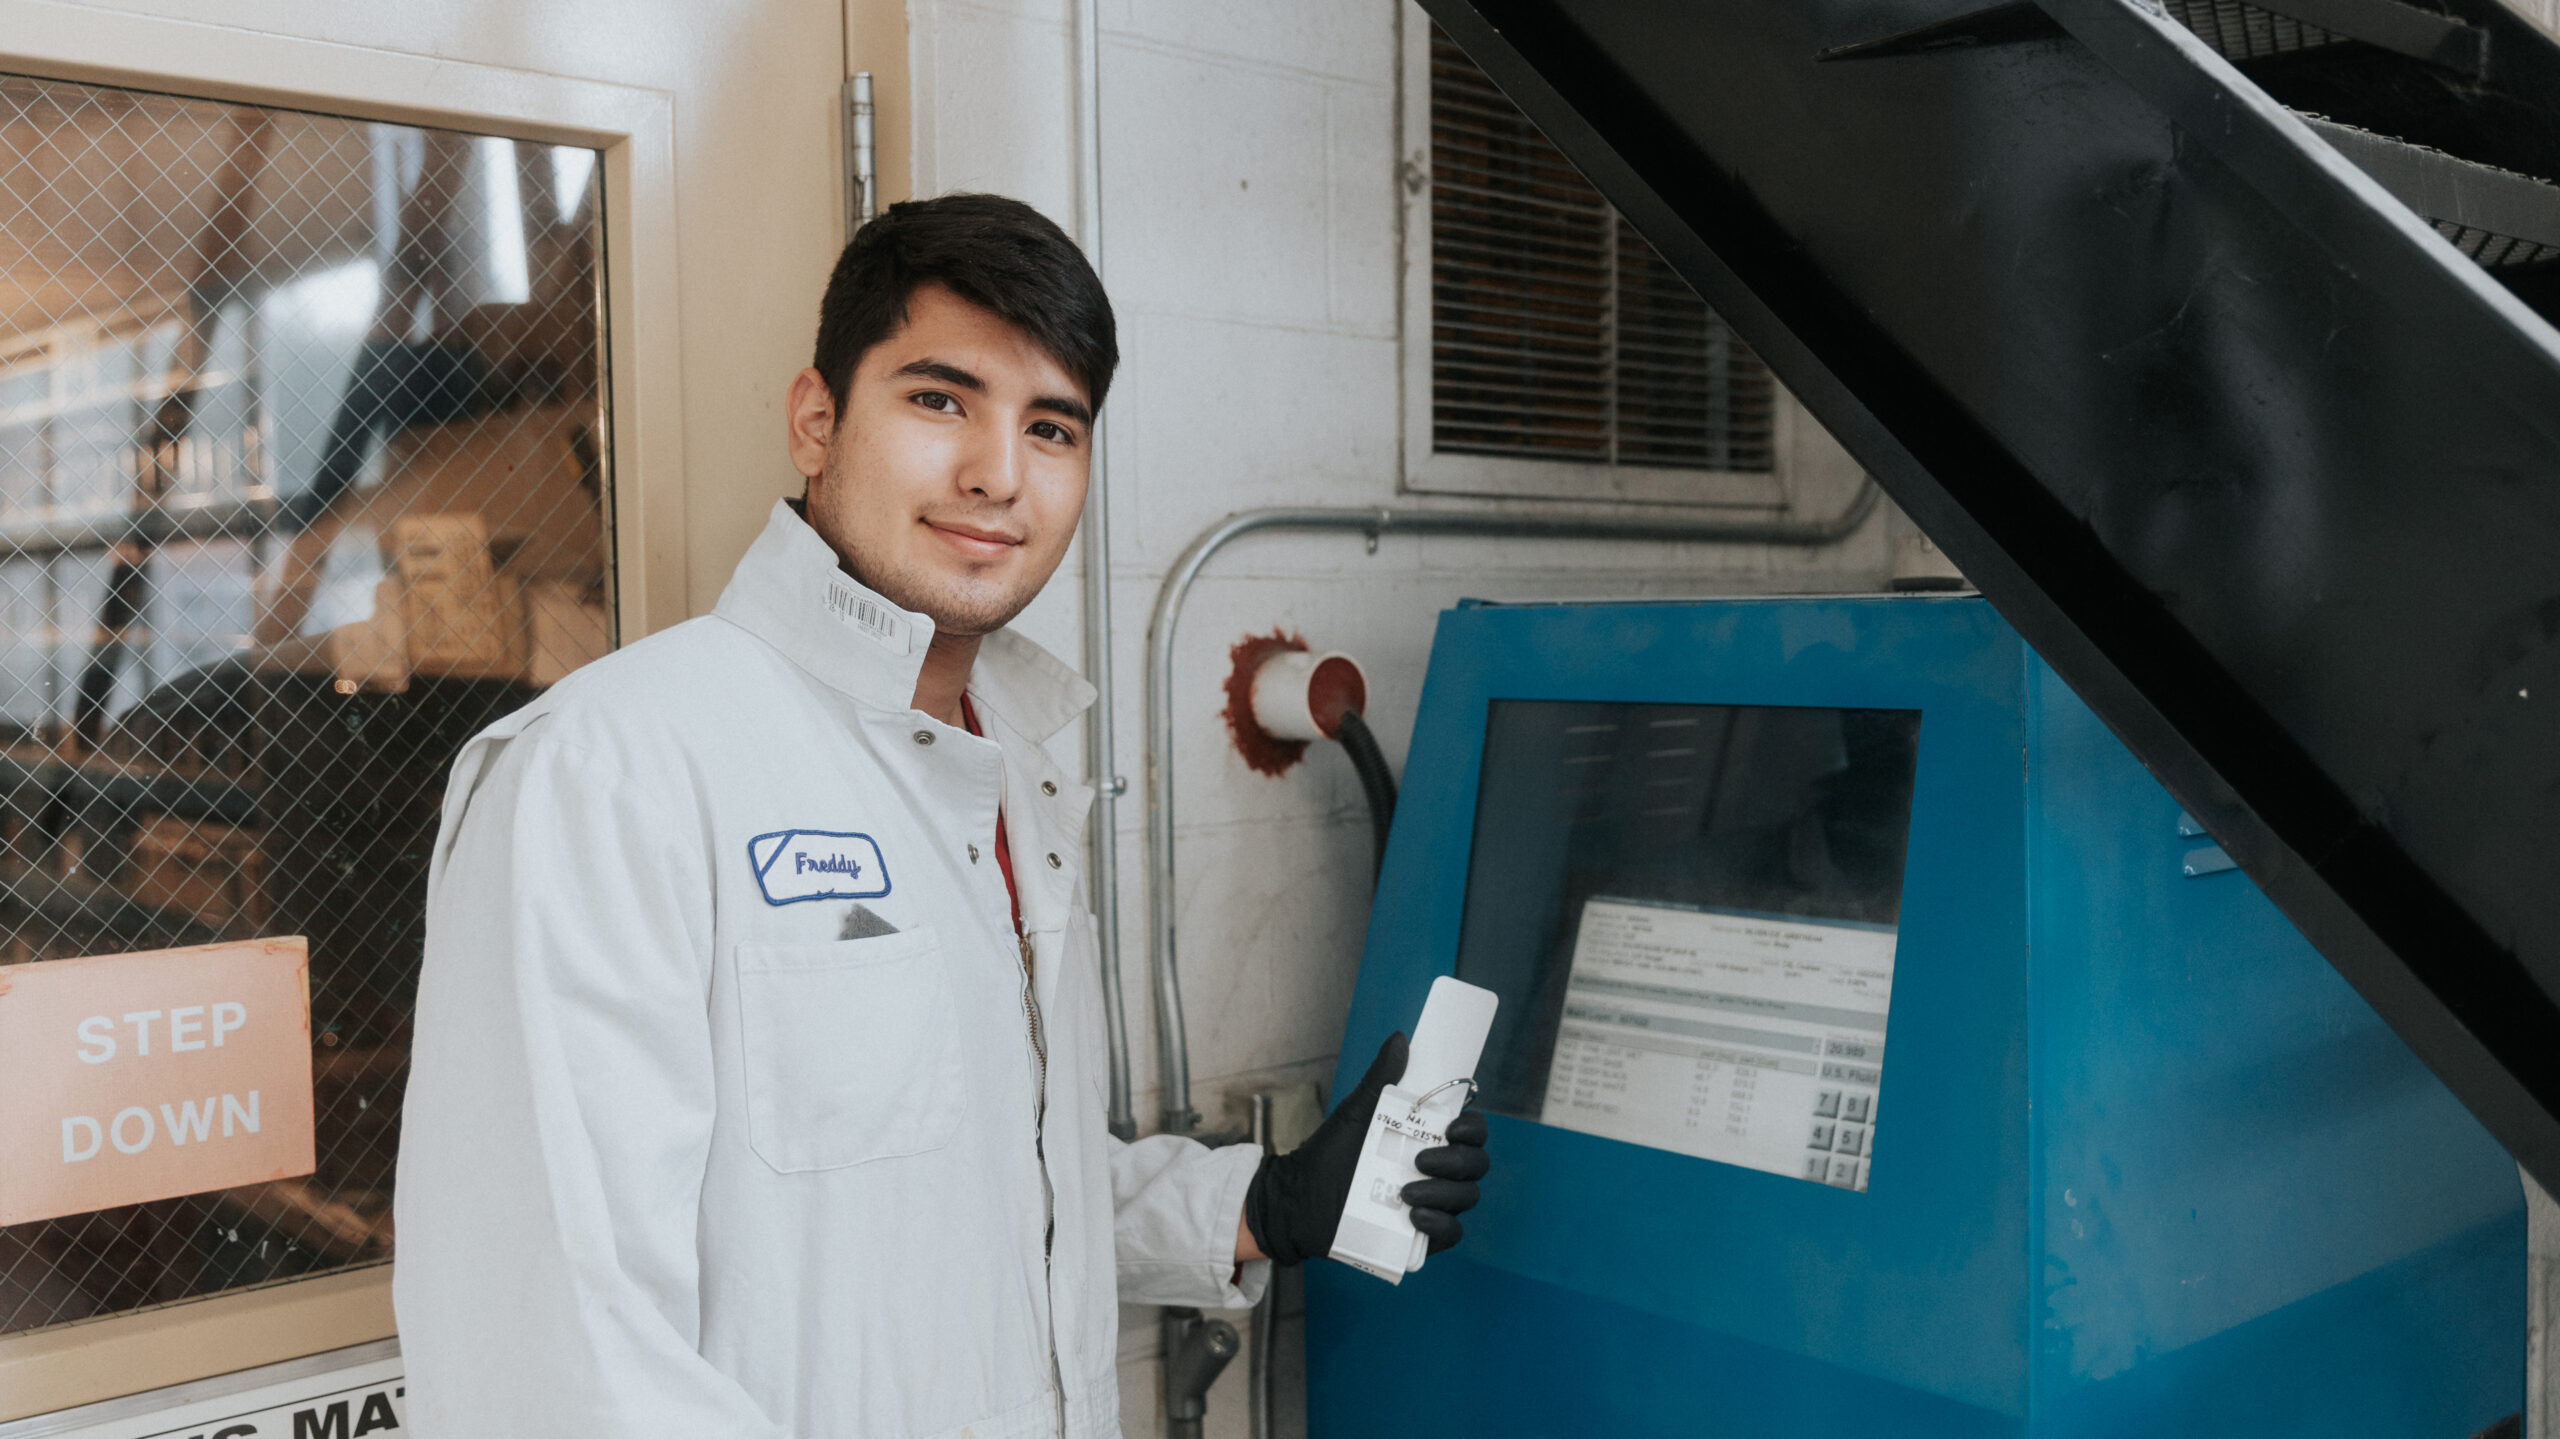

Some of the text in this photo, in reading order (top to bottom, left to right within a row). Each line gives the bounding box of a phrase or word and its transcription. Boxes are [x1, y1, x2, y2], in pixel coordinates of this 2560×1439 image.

[795, 852, 861, 880] Freddy
[76, 1001, 247, 1064] STEP
[1819, 1093, 1856, 1112] 7 8
[61, 1090, 260, 1163] DOWN
[1813, 1126, 1851, 1144] 4 5
[1835, 1163, 1846, 1178] 2
[293, 1387, 405, 1439] MA
